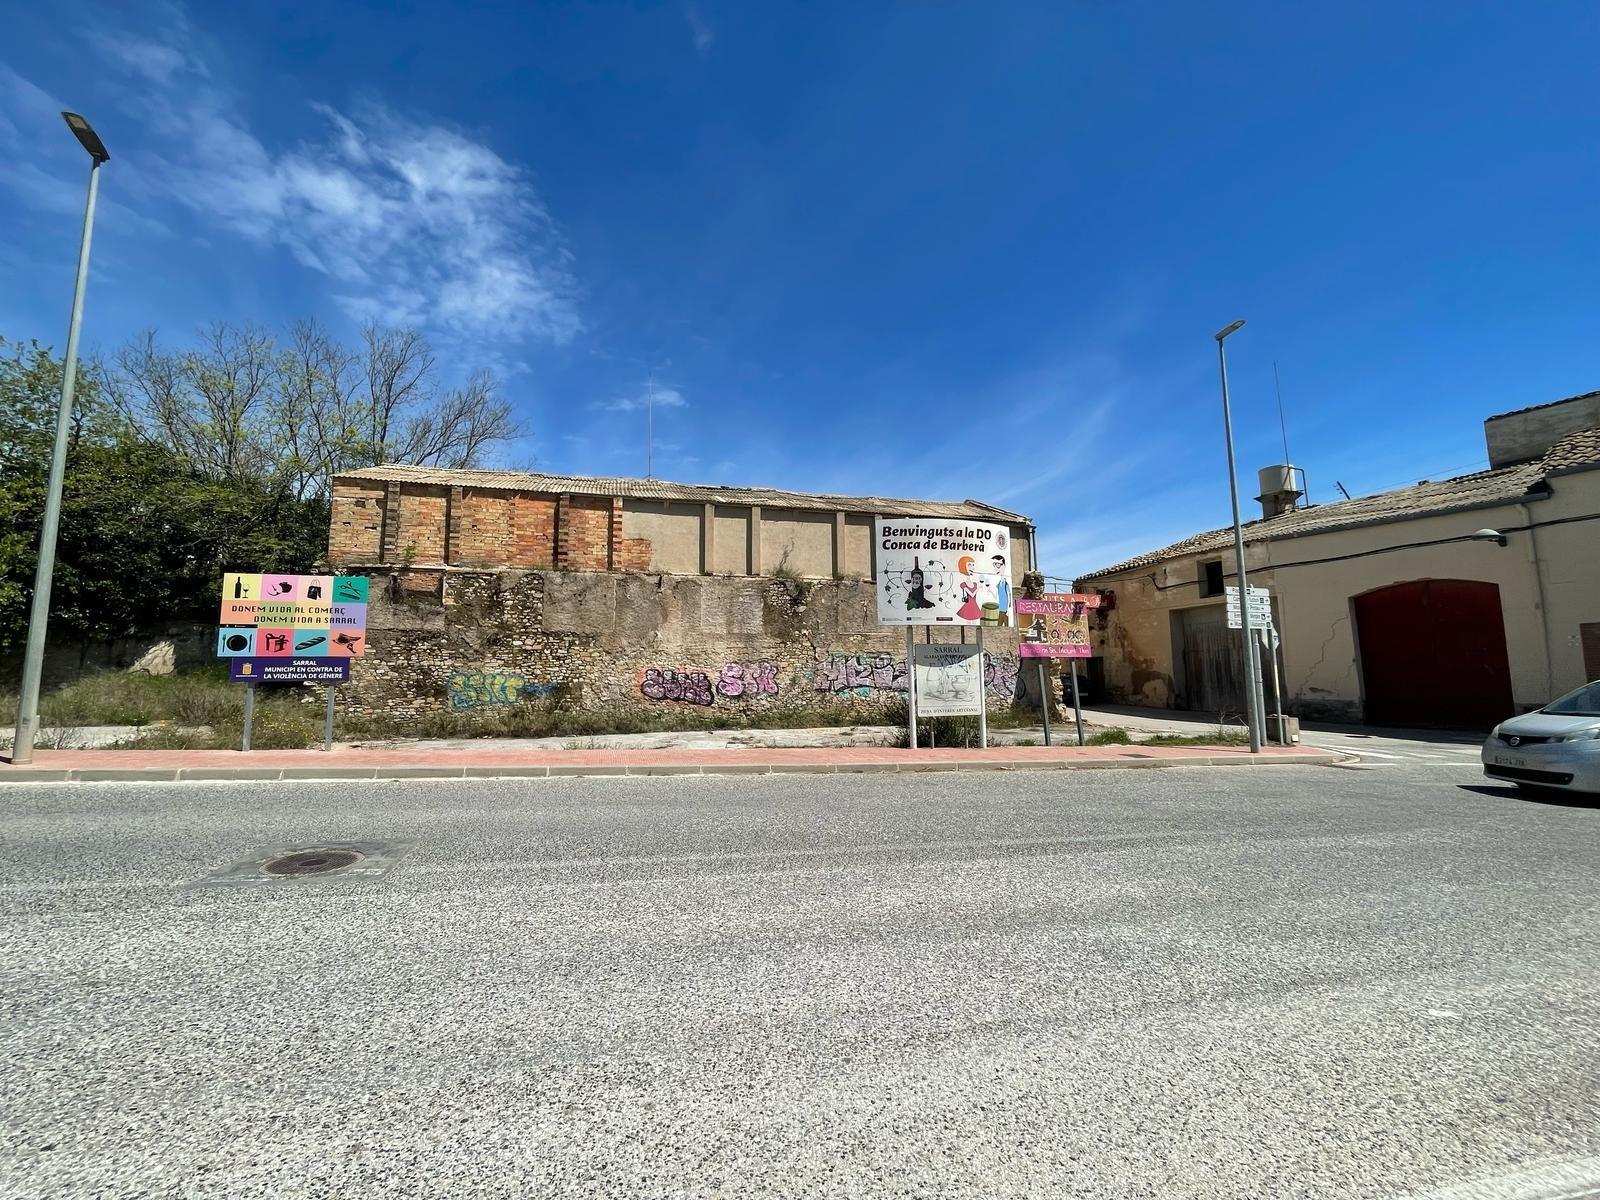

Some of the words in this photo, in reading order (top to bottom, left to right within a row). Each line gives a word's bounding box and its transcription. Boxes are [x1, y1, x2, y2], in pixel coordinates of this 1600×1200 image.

[882, 524, 954, 539] Benvinguts
[956, 528, 963, 537] a
[964, 527, 974, 538] la
[976, 528, 992, 540] DO
[882, 539, 921, 550] Conca
[923, 540, 938, 550] de
[940, 539, 985, 552] Barberà
[231, 605, 266, 613] DONEM
[308, 606, 346, 615] COMERÇ
[253, 615, 288, 623] DONEM
